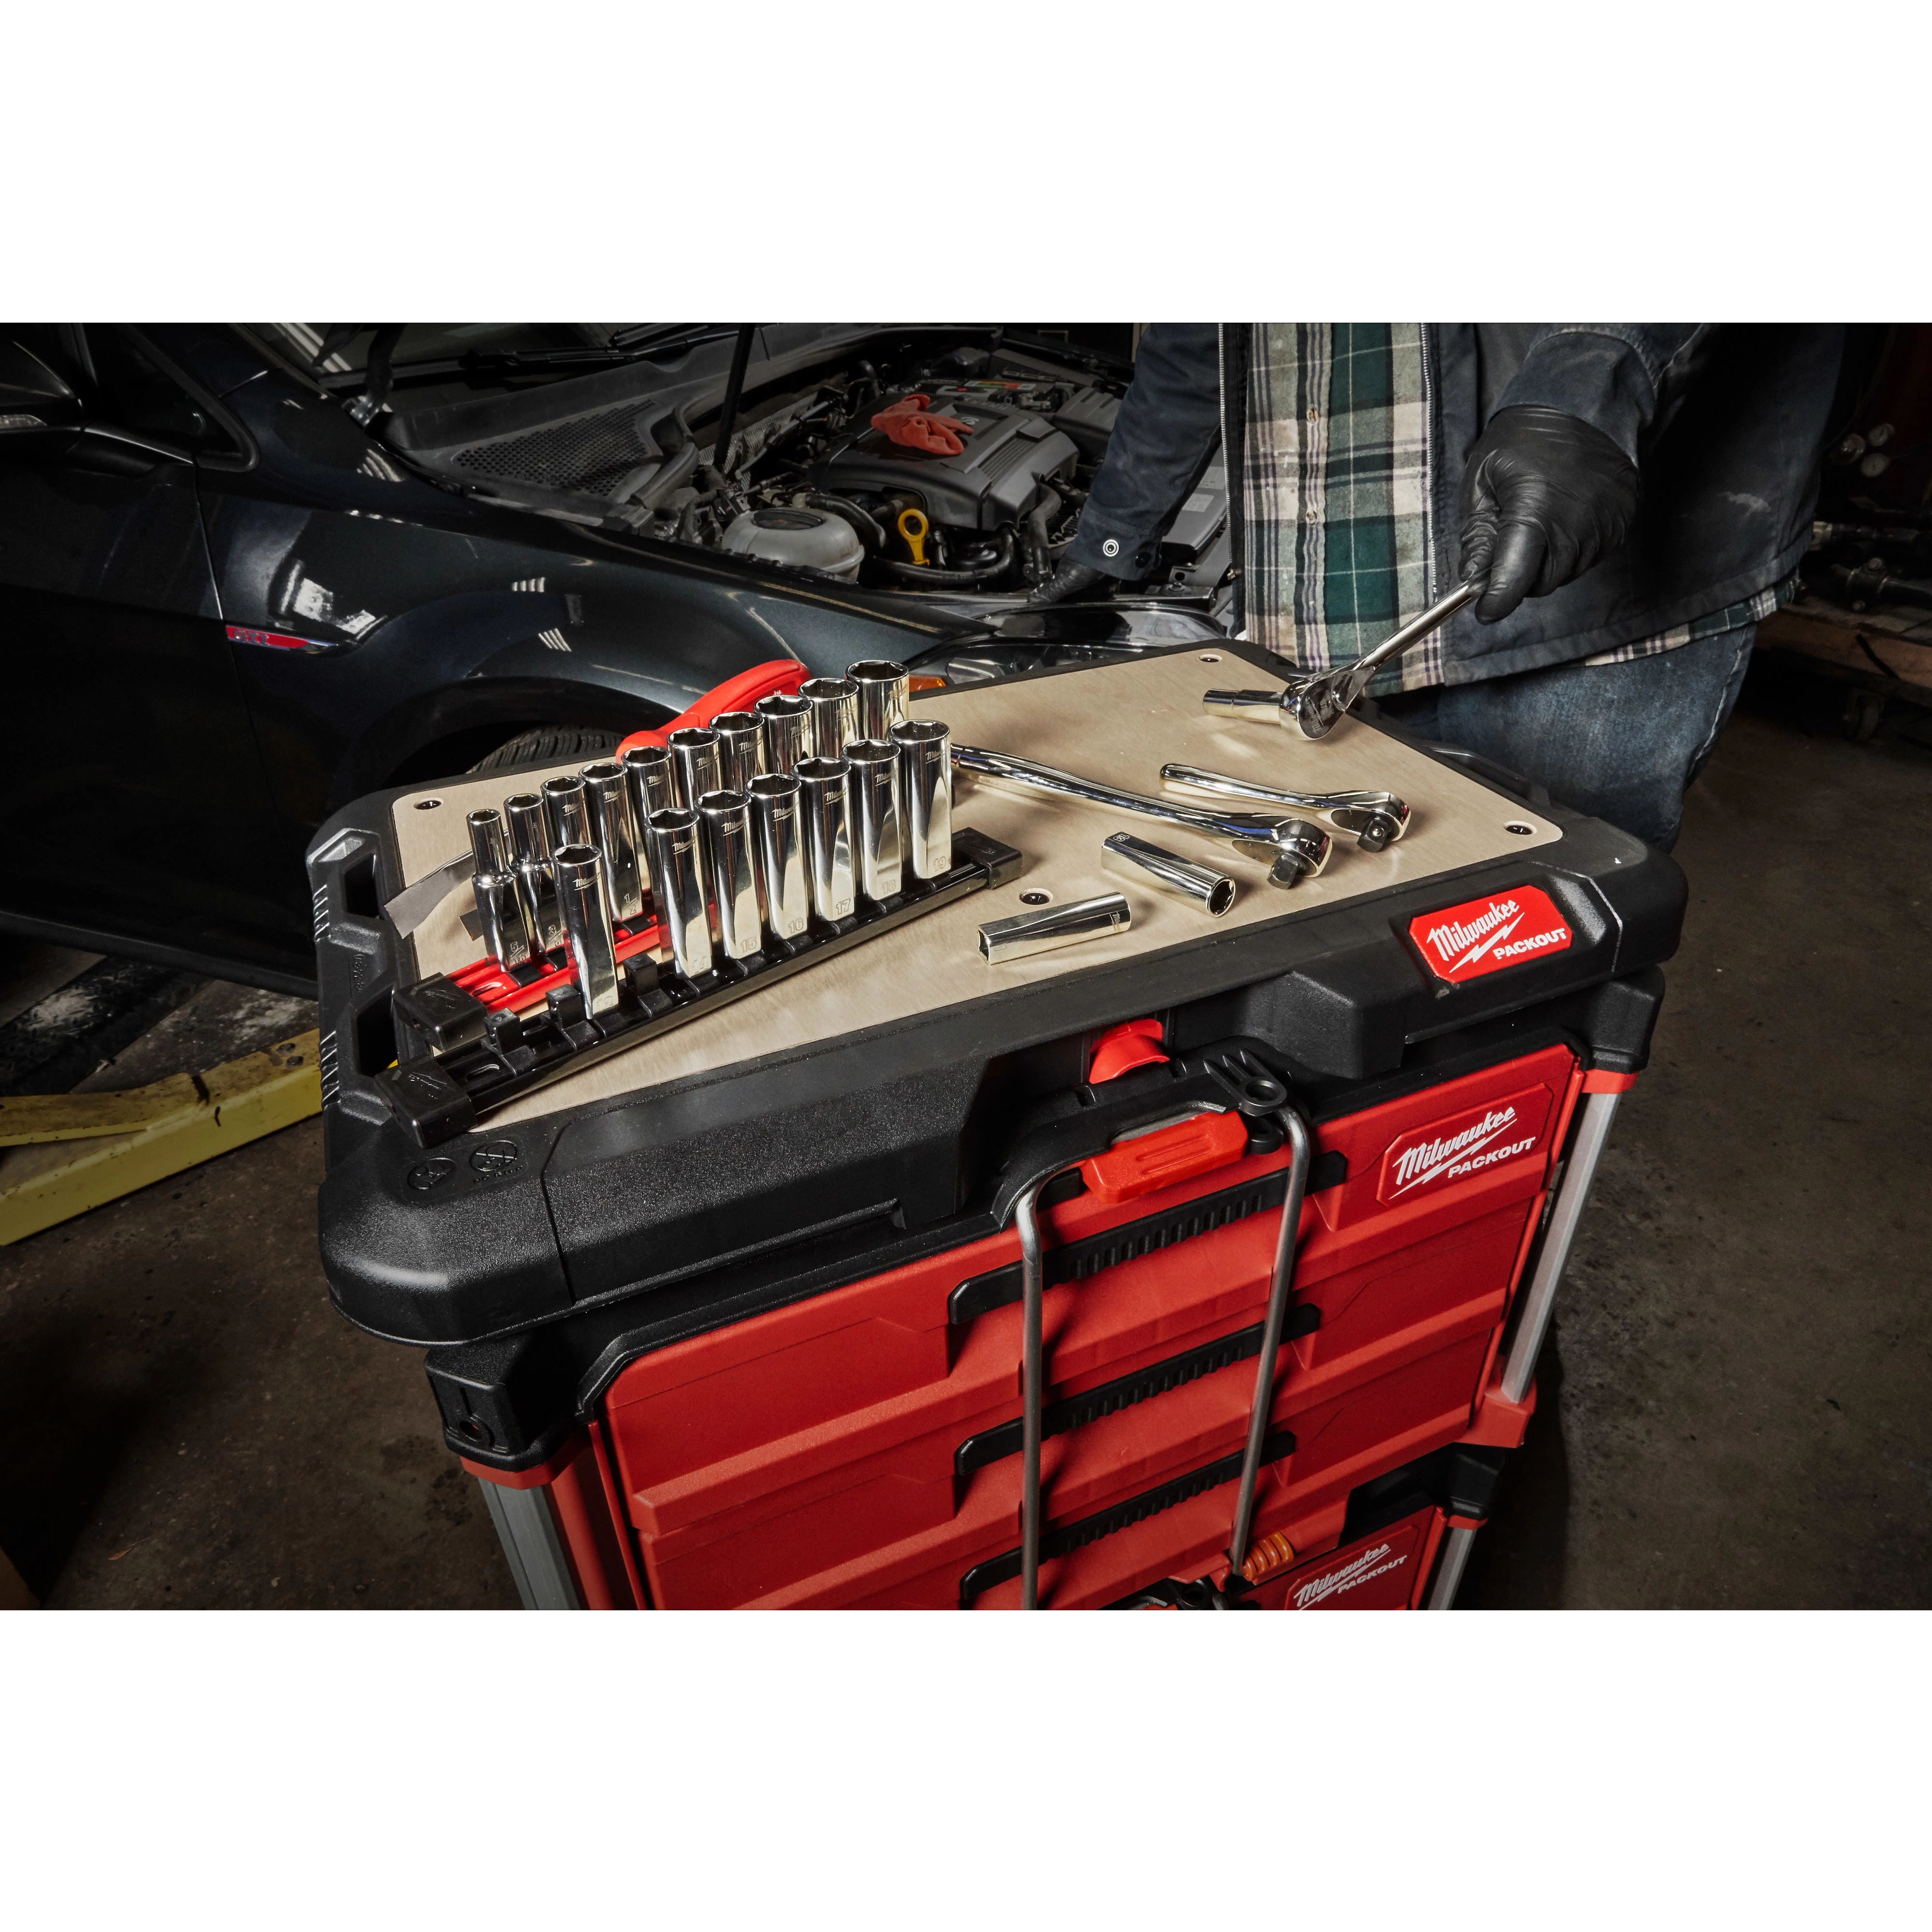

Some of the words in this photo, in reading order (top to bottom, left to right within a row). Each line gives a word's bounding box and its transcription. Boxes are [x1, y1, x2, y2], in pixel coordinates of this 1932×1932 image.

[933, 855, 946, 871] 19
[882, 879, 896, 895] 18
[836, 897, 851, 915] 17
[788, 917, 804, 934] 16
[1426, 899, 1520, 961] Milwaukee
[740, 935, 757, 953] 15
[1492, 927, 1567, 960] PACKOUT
[1392, 1106, 1516, 1185] Milwaukee
[1448, 1136, 1536, 1179] PACKOUT
[1293, 1543, 1390, 1607] Milwaukee
[1338, 1555, 1407, 1594] PACKOUT
